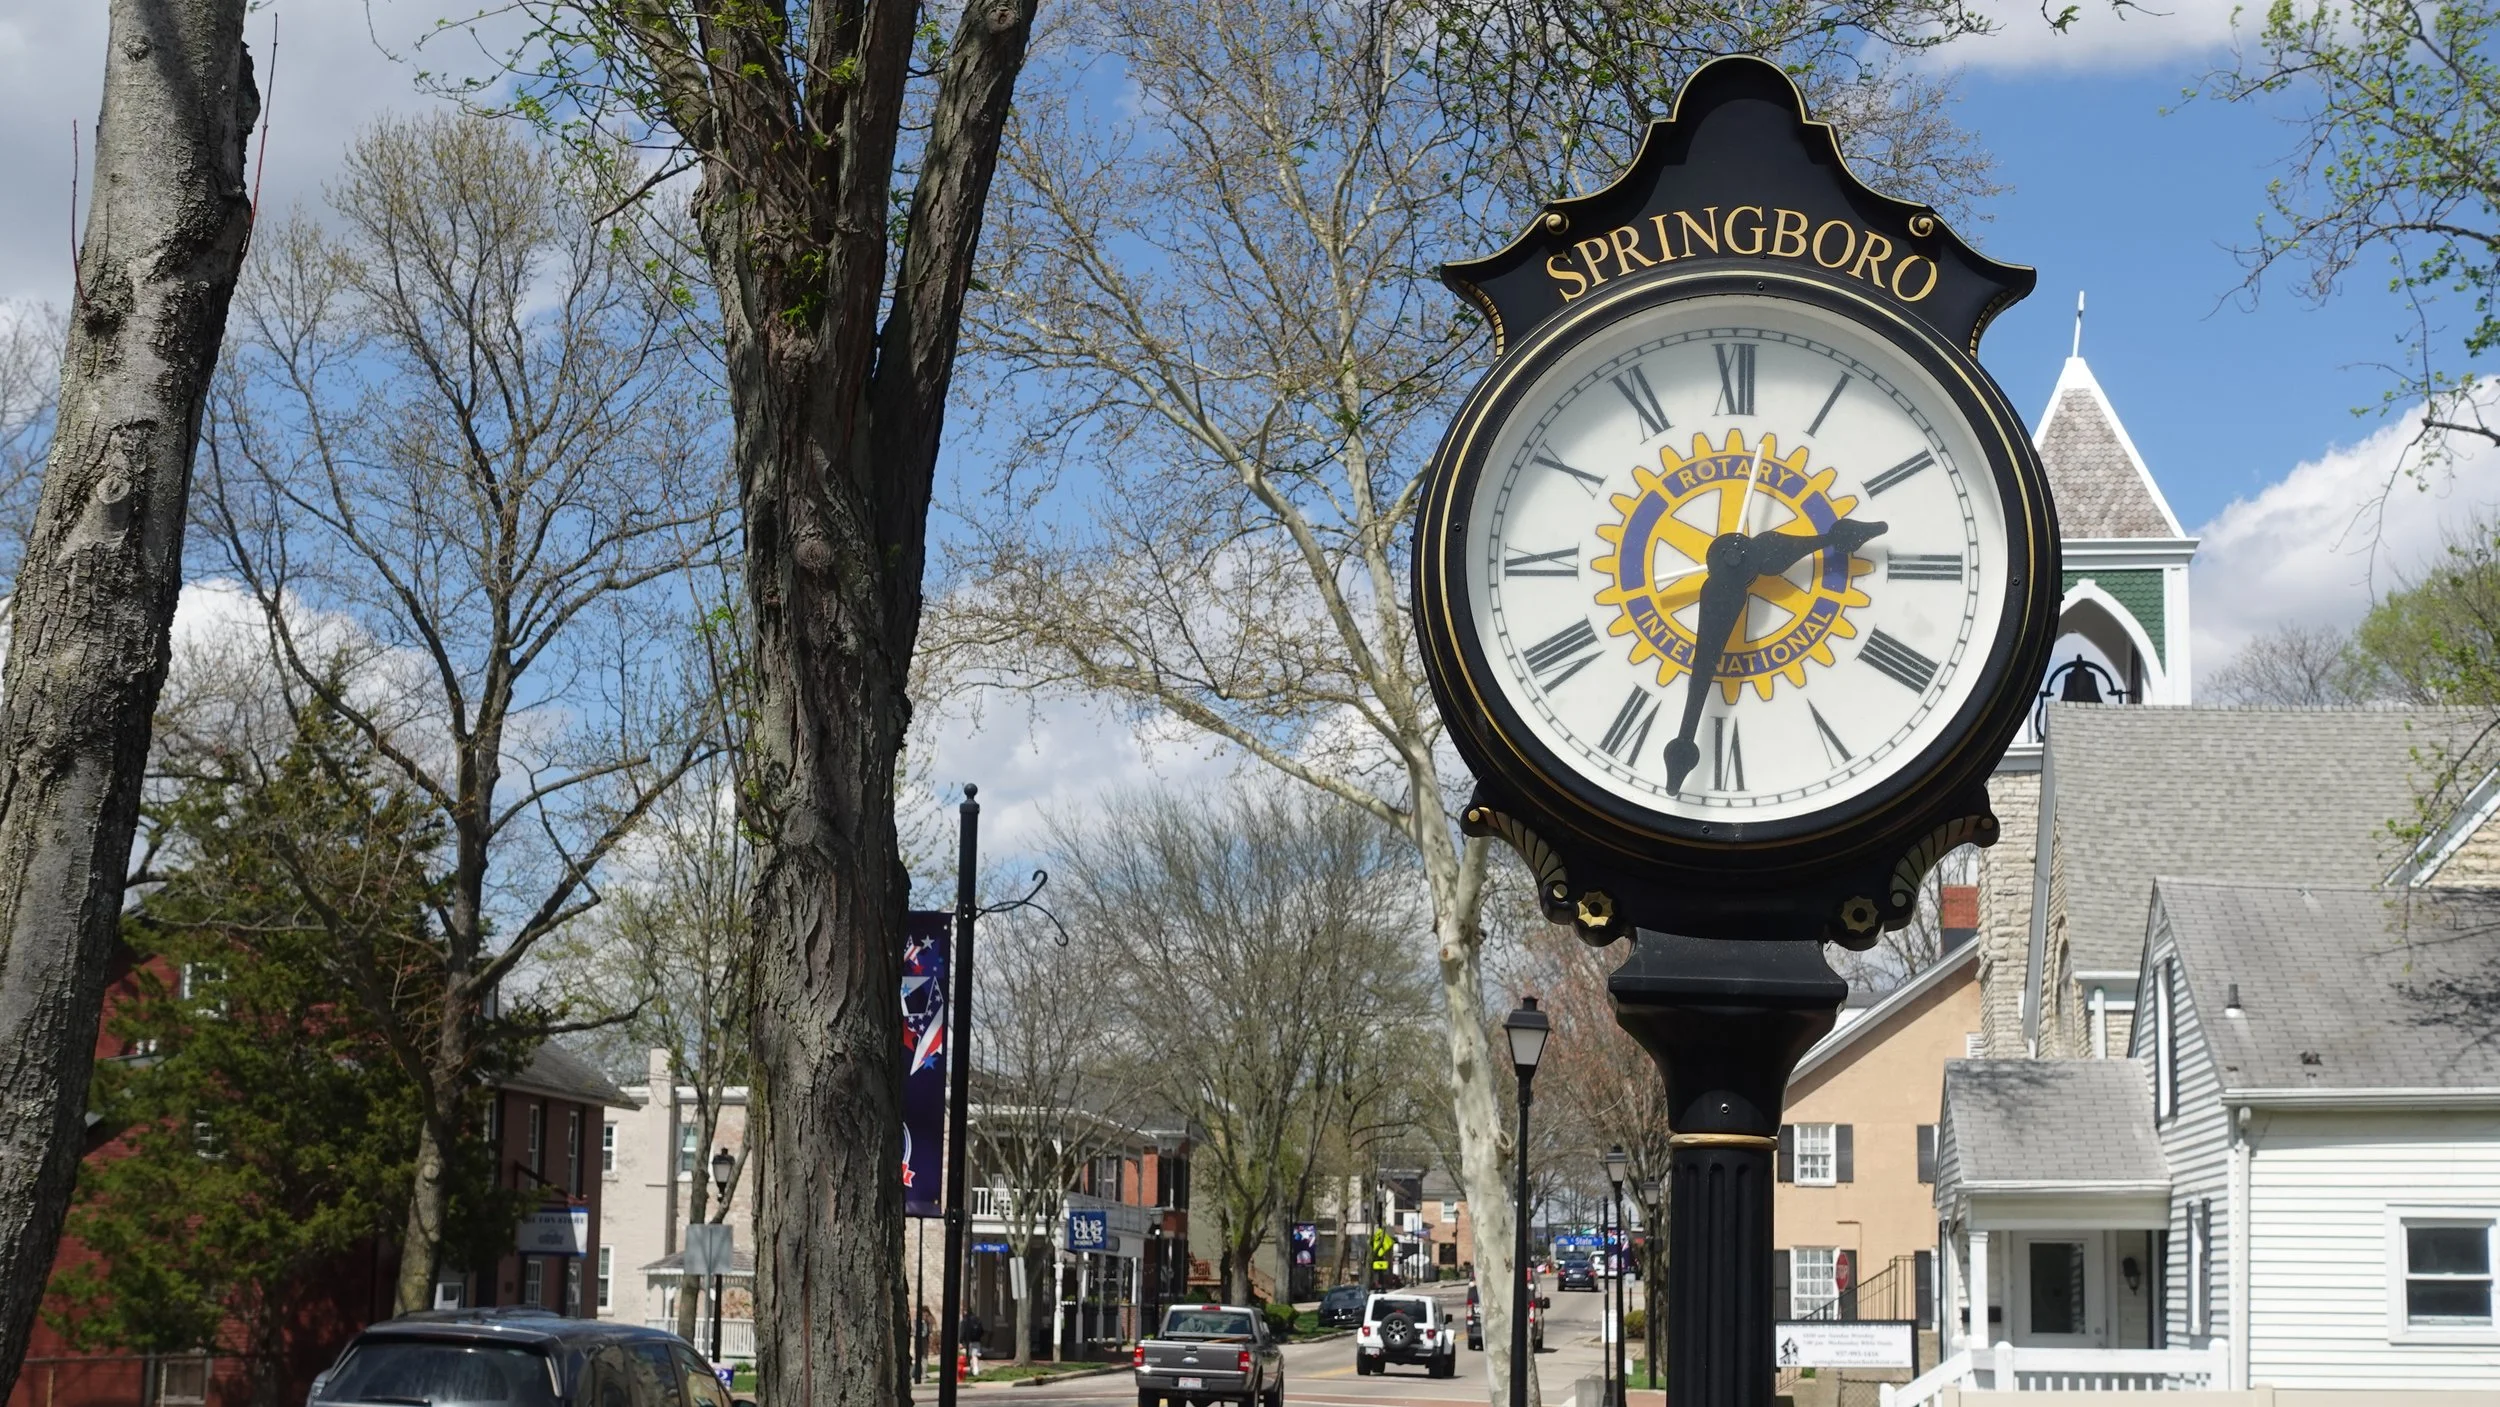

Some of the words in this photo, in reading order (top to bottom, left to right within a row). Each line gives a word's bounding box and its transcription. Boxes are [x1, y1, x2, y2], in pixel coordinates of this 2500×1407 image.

[1545, 205, 1939, 303] SPRINGBORO
[1607, 363, 1674, 444] XI
[1711, 343, 1760, 416] XII
[1803, 371, 1854, 438] I
[1531, 438, 1608, 498] X
[1677, 457, 1794, 490] ROTARY
[1861, 448, 1937, 499] II
[1504, 541, 1580, 581] IX
[1886, 550, 1963, 584] III
[1521, 615, 1606, 698] VIII
[1854, 624, 1941, 698] IIII
[1594, 683, 1663, 769] VII
[1709, 715, 1750, 792] VI
[1806, 698, 1857, 769] V
[1072, 1215, 1102, 1232] blue
[1074, 1225, 1104, 1244] dog
[1575, 1237, 1593, 1245] State
